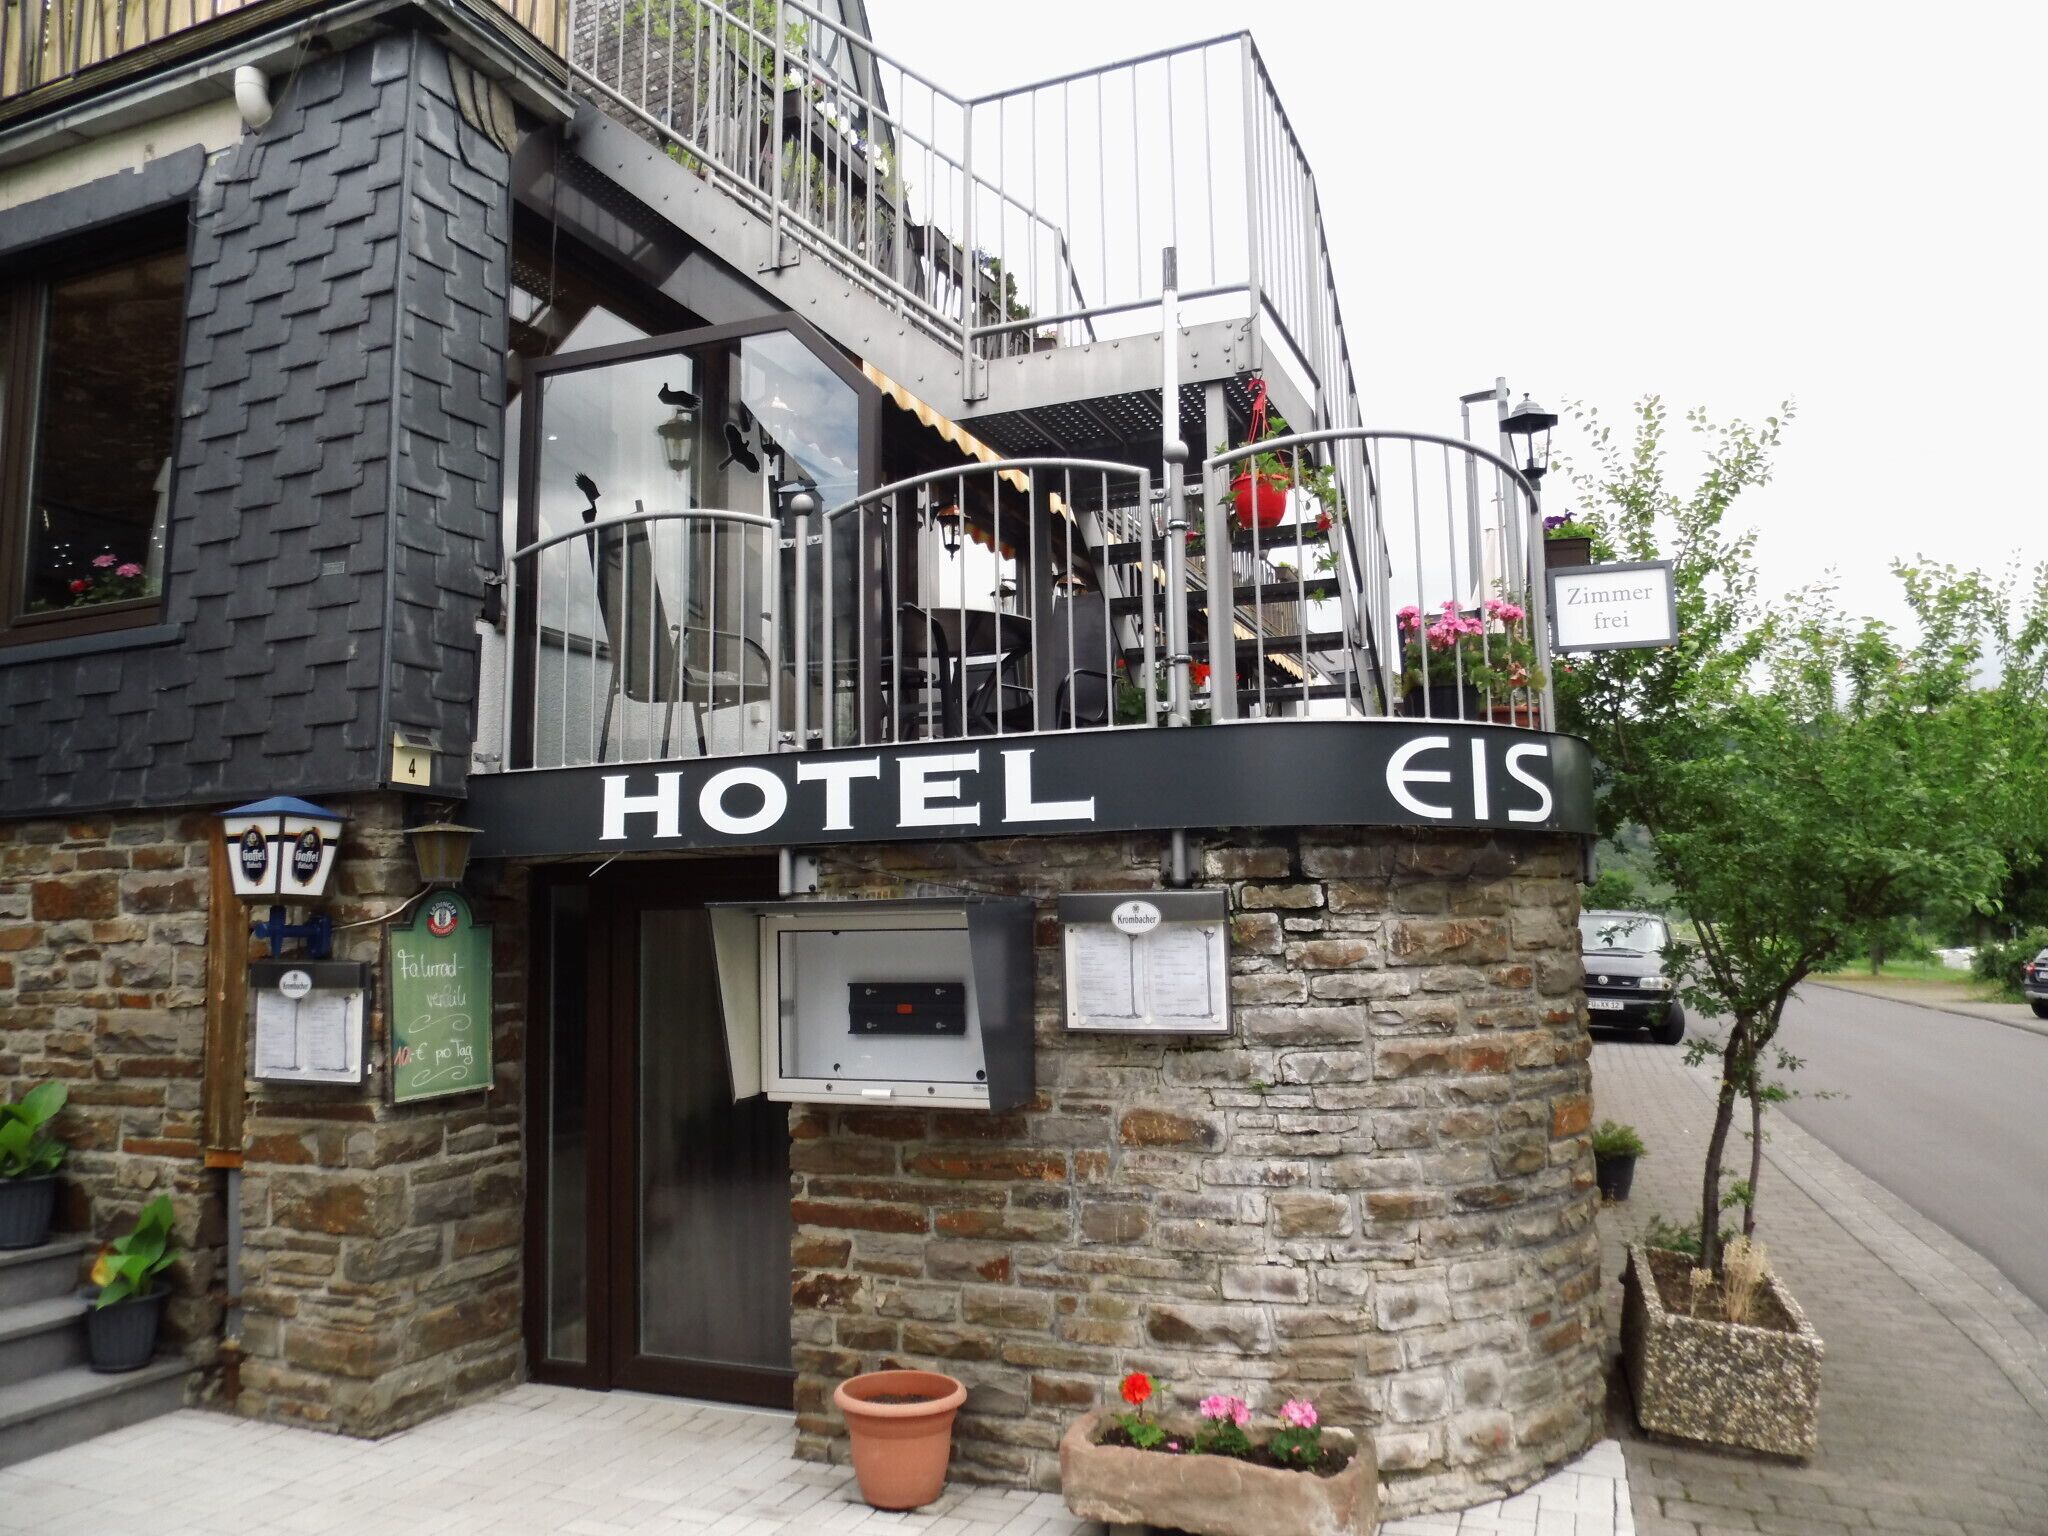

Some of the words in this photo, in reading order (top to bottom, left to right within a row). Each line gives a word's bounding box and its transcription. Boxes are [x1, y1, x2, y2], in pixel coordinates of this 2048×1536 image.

[1567, 587, 1653, 605] Zimmer
[1594, 610, 1629, 629] frei
[408, 758, 417, 778] 4
[1386, 736, 1553, 823] EIS
[599, 749, 1095, 841] HOTEL
[242, 849, 266, 863] Gaffel
[295, 849, 319, 864] Gaffel
[1117, 913, 1157, 925] Krombacher
[450, 1039, 473, 1065] Tag
